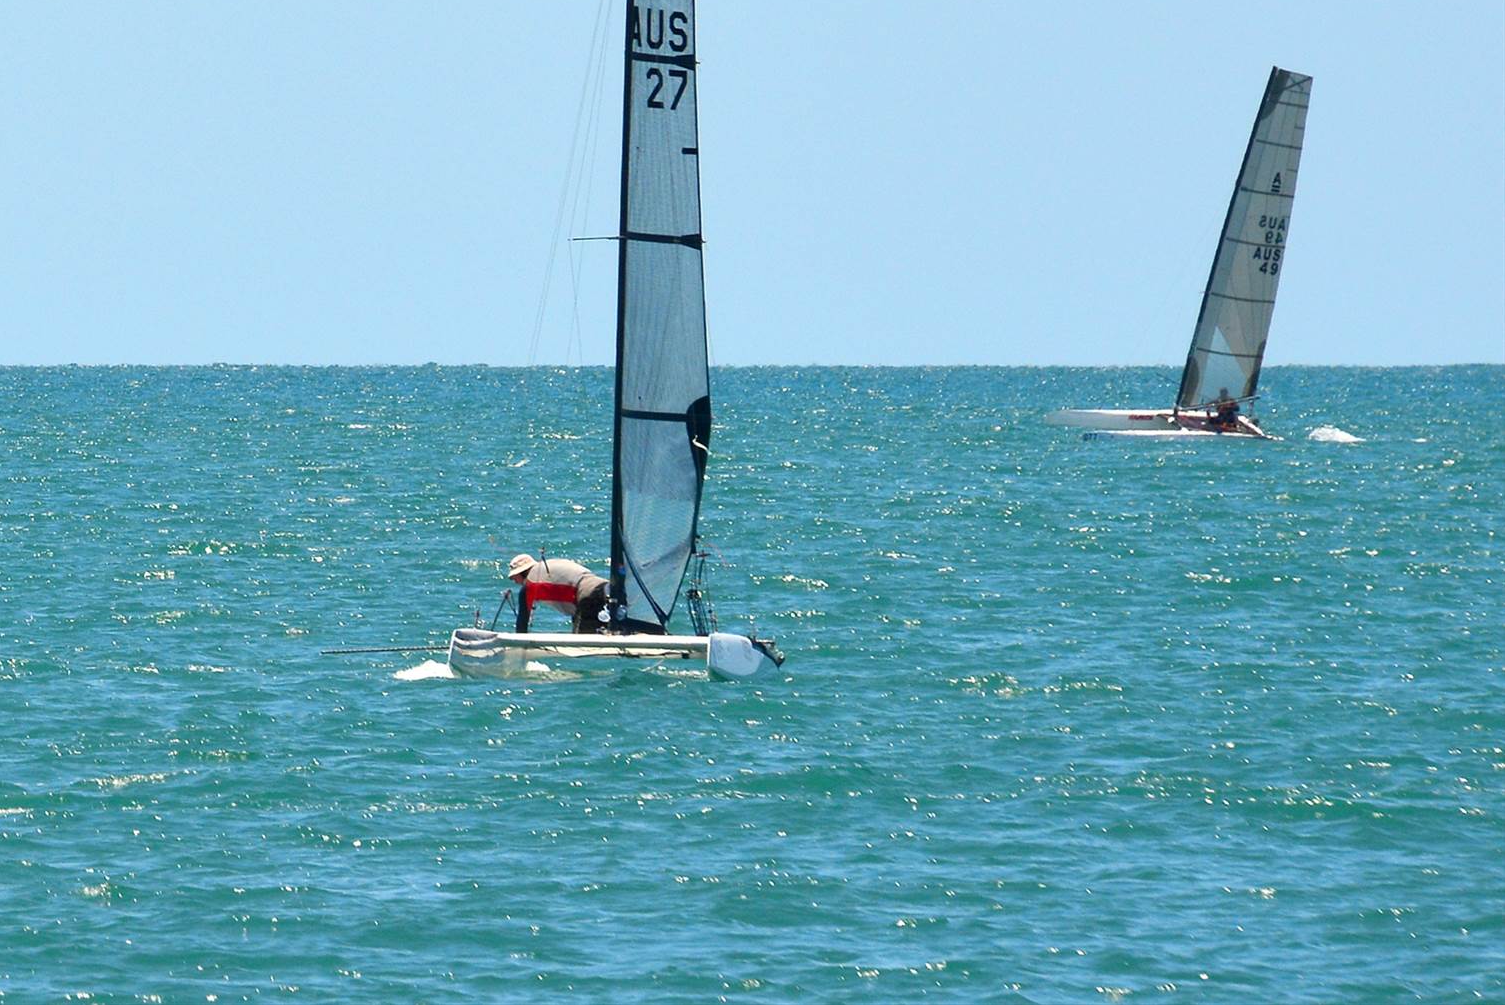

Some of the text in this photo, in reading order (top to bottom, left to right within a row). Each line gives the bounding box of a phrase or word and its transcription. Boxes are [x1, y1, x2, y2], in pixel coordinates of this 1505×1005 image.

[646, 67, 688, 111] 27
[1252, 246, 1282, 262] AUS
[1259, 262, 1279, 276] 49
